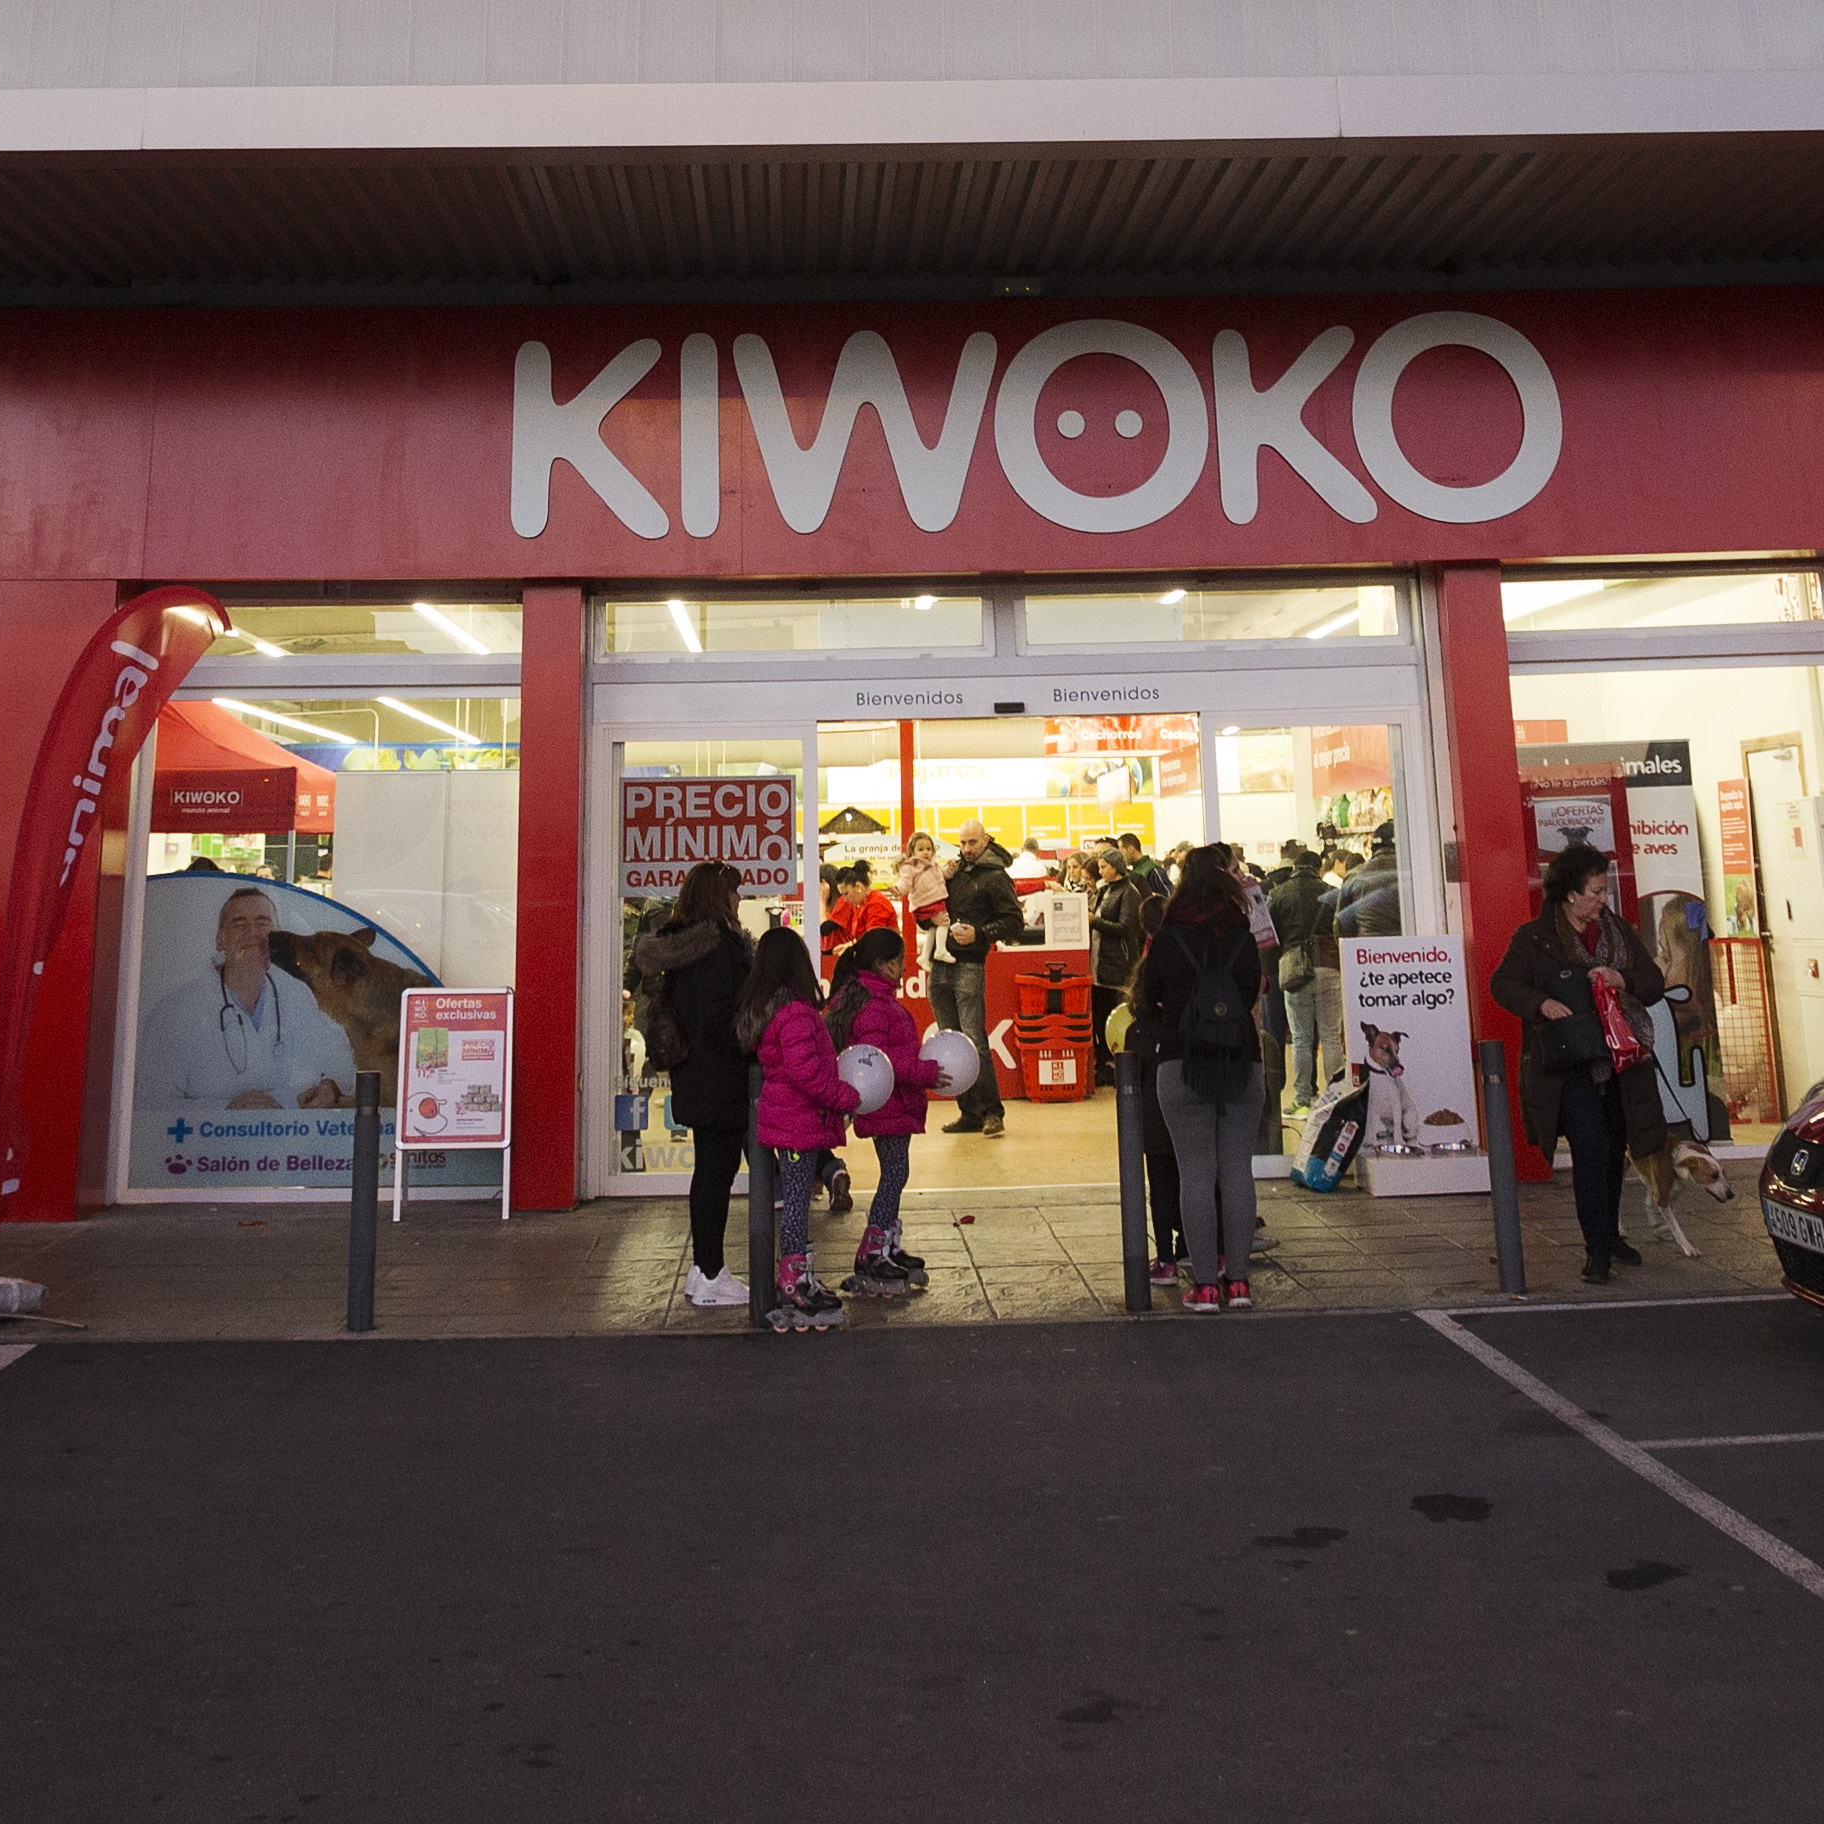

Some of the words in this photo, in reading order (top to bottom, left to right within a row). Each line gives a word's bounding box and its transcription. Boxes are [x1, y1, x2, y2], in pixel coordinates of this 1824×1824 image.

[511, 311, 1563, 540] KIWOKO
[856, 691, 963, 706] Bienvenidos
[1053, 687, 1160, 703] Bienvenidos
[1081, 729, 1142, 741] Cachorros
[174, 790, 240, 805] KIWOKO
[626, 783, 789, 819] PRECIO
[626, 817, 790, 861] MÍNIMO
[859, 844, 889, 855] granja
[1643, 843, 1678, 855] aves
[626, 867, 789, 888] GARAADO
[1357, 947, 1453, 965] Bienvenido,
[1360, 972, 1385, 988] ¿te
[1388, 971, 1453, 989] apetece
[436, 998, 482, 1009] Ofertas
[1359, 991, 1408, 1008] tomar
[1412, 988, 1455, 1010] algo?
[436, 1010, 496, 1020] exclusivas
[199, 1120, 310, 1138] Consultorio
[196, 1154, 250, 1173] Salón
[256, 1154, 280, 1172] de
[286, 1155, 354, 1172] Belleza
